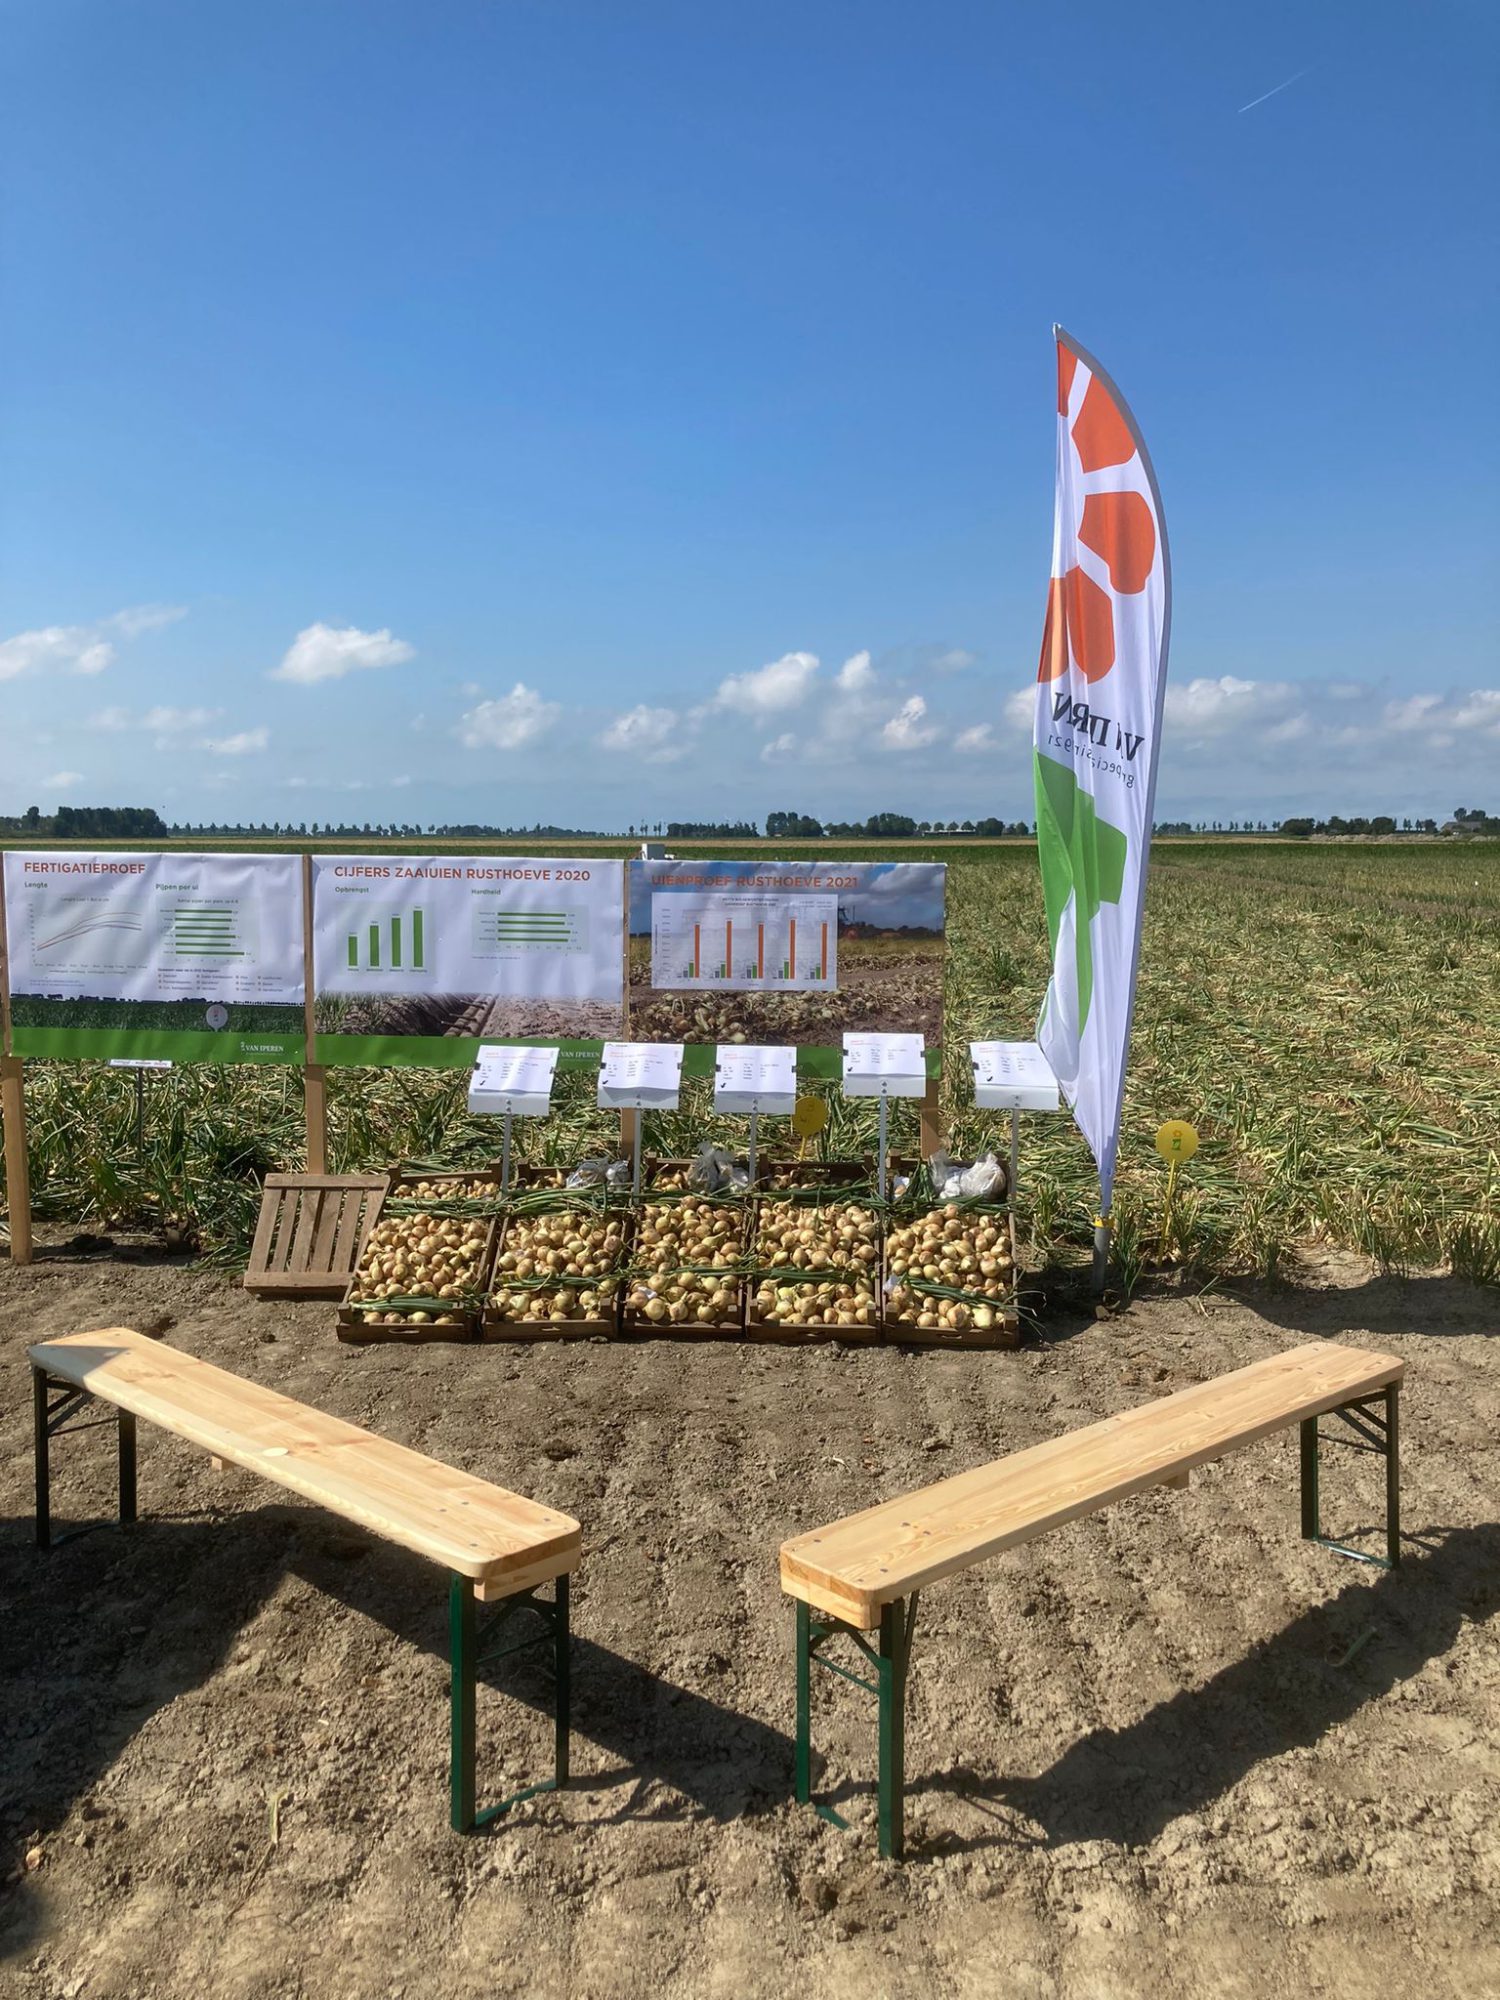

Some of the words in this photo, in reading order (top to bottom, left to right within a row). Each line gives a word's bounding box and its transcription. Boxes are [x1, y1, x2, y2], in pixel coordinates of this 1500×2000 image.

[24, 862, 146, 874] FERTIGATIEPROEF
[334, 866, 391, 878] CIJFERS
[395, 867, 462, 878] ZAAIUIEN
[466, 868, 551, 880] RUSTHOEVE
[555, 870, 591, 881] 2020
[24, 881, 48, 889] Lengte
[651, 874, 732, 887] UIENPROEF
[736, 875, 821, 887] RUSTHOEVE
[826, 876, 859, 888] 2021
[155, 883, 177, 891] Pijpen
[178, 884, 190, 892] per
[334, 886, 369, 894] Opbrengst
